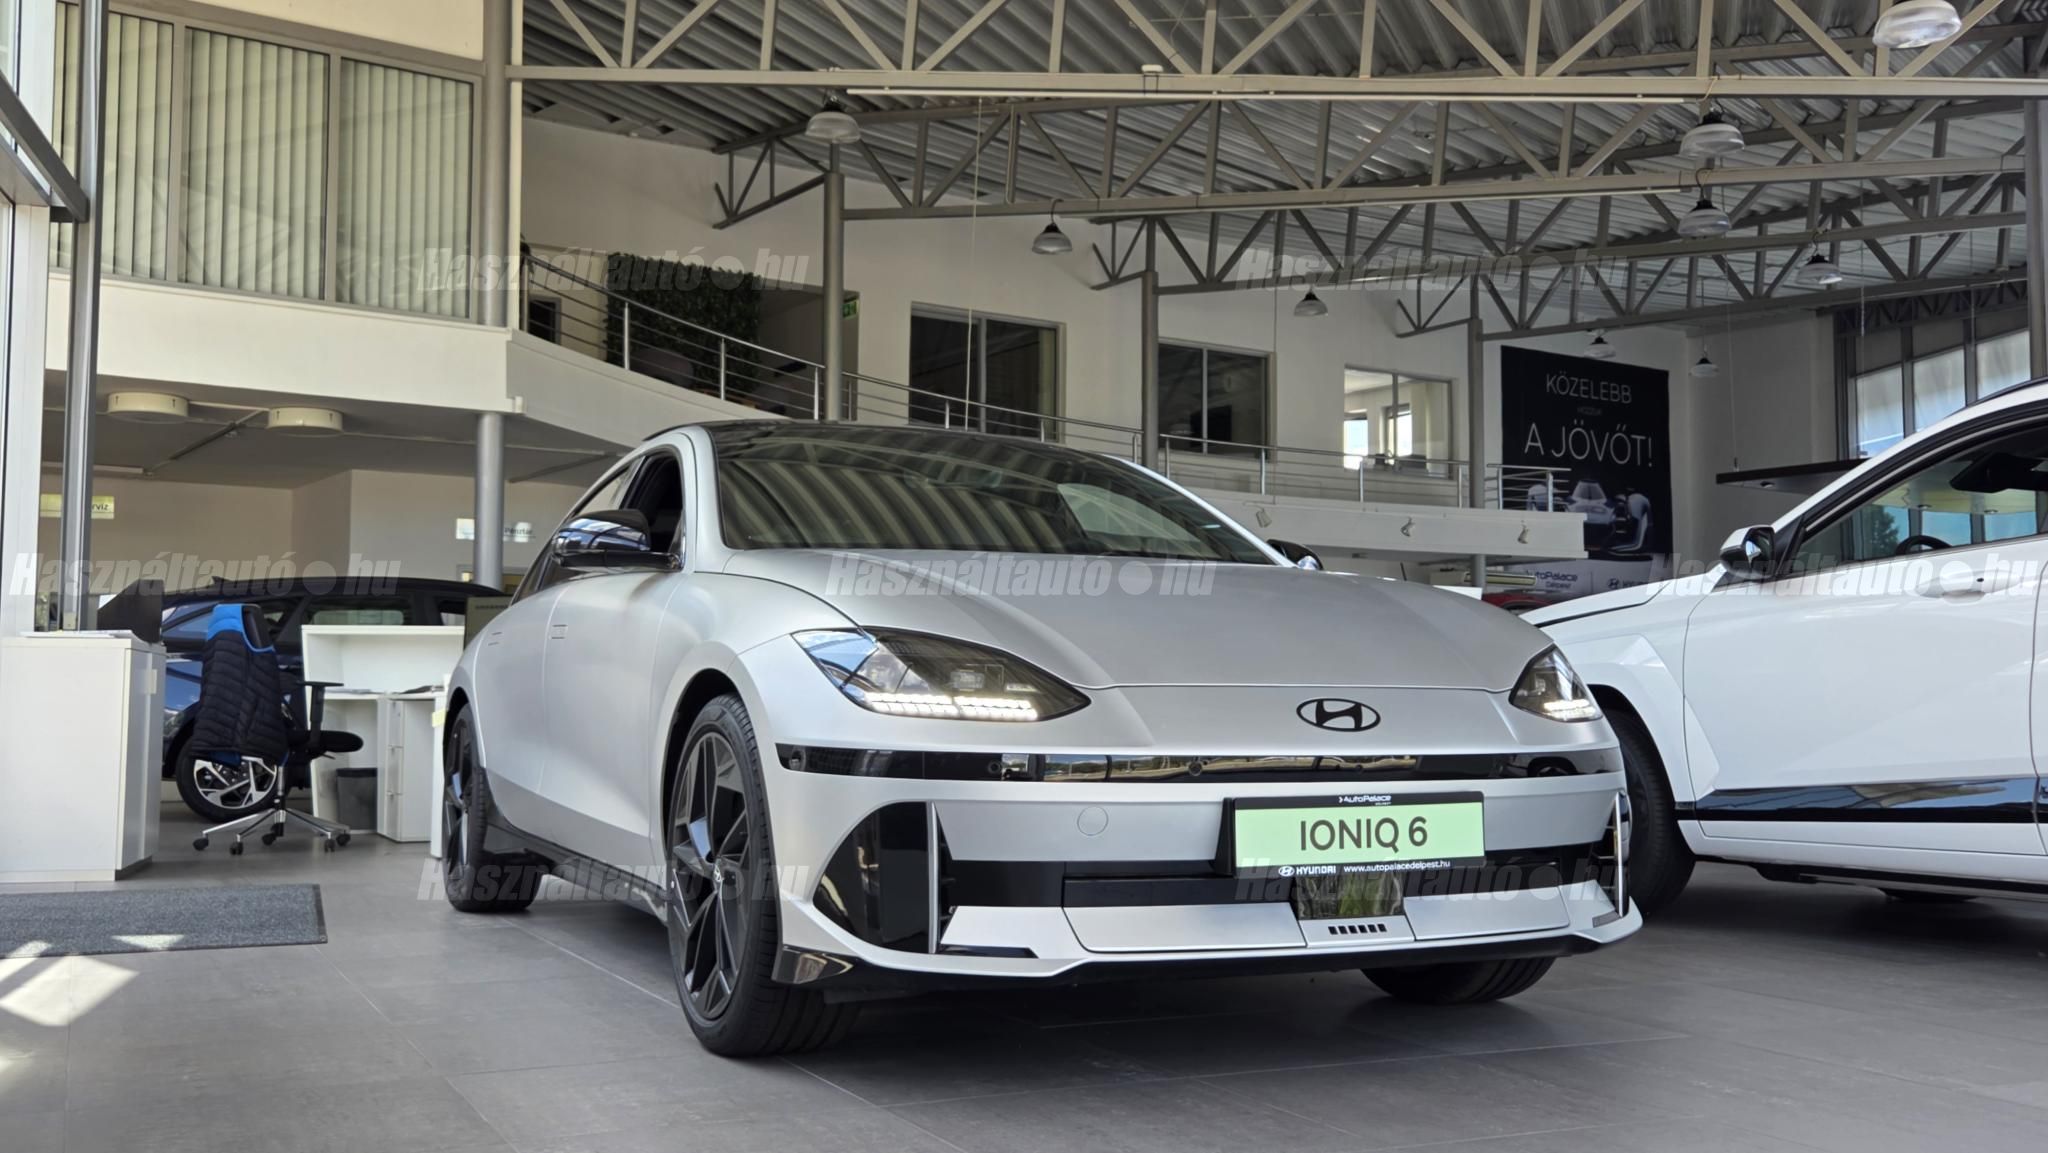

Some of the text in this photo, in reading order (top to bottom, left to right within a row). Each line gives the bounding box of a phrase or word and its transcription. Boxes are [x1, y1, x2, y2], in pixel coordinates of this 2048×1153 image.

[1546, 370, 1632, 404] KÖZELEBB
[1524, 418, 1652, 467] A JÖVŐT!
[1300, 816, 1428, 853] IONIQ 6
[1296, 860, 1451, 875] HYUNDAI www.autopalacedelpest.hu
